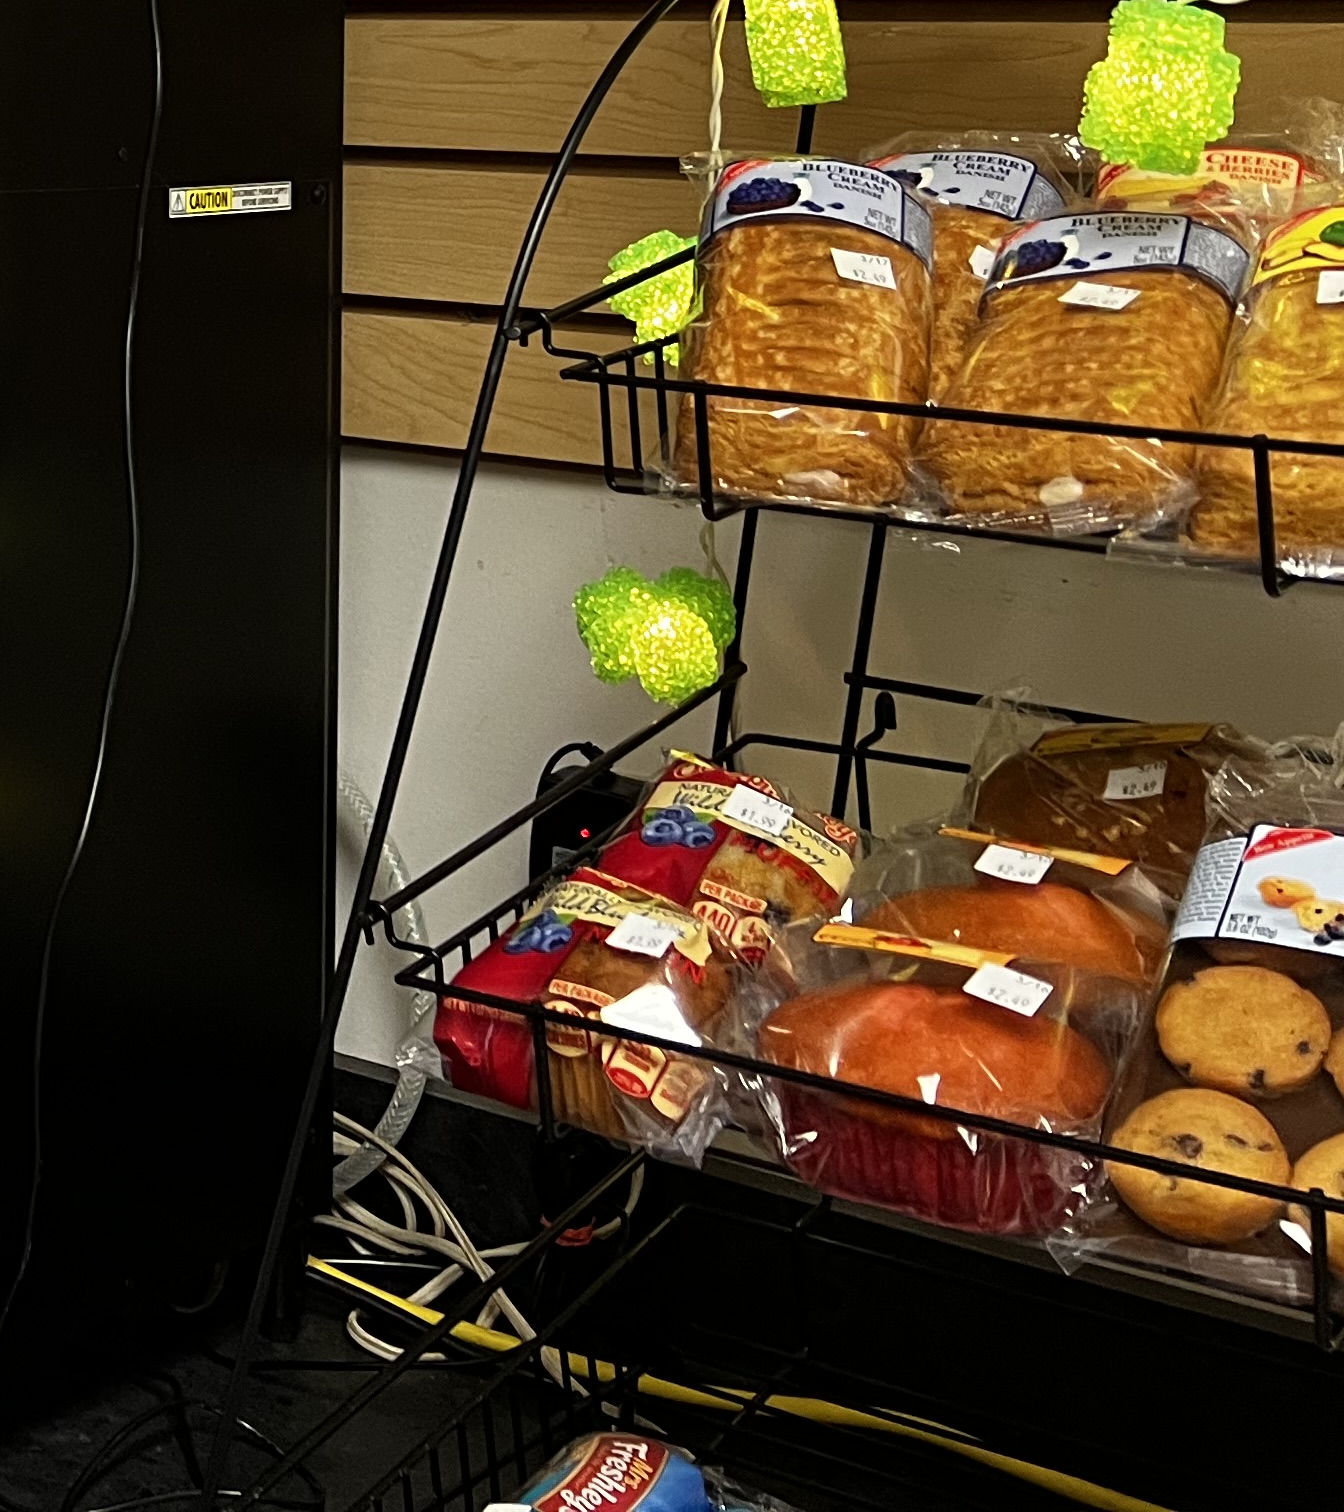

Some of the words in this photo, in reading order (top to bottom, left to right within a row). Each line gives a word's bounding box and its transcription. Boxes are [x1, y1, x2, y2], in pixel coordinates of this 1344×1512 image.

[931, 153, 1031, 174] BLUEBERRY
[953, 161, 1012, 177] CREAM
[1205, 152, 1295, 171] CHEESE
[801, 162, 900, 193] BLUEBERRY
[827, 172, 885, 195] CREAM
[189, 191, 229, 209] CAUTION
[1072, 216, 1185, 229] BLUEBERRY
[1097, 222, 1163, 233] CREAM
